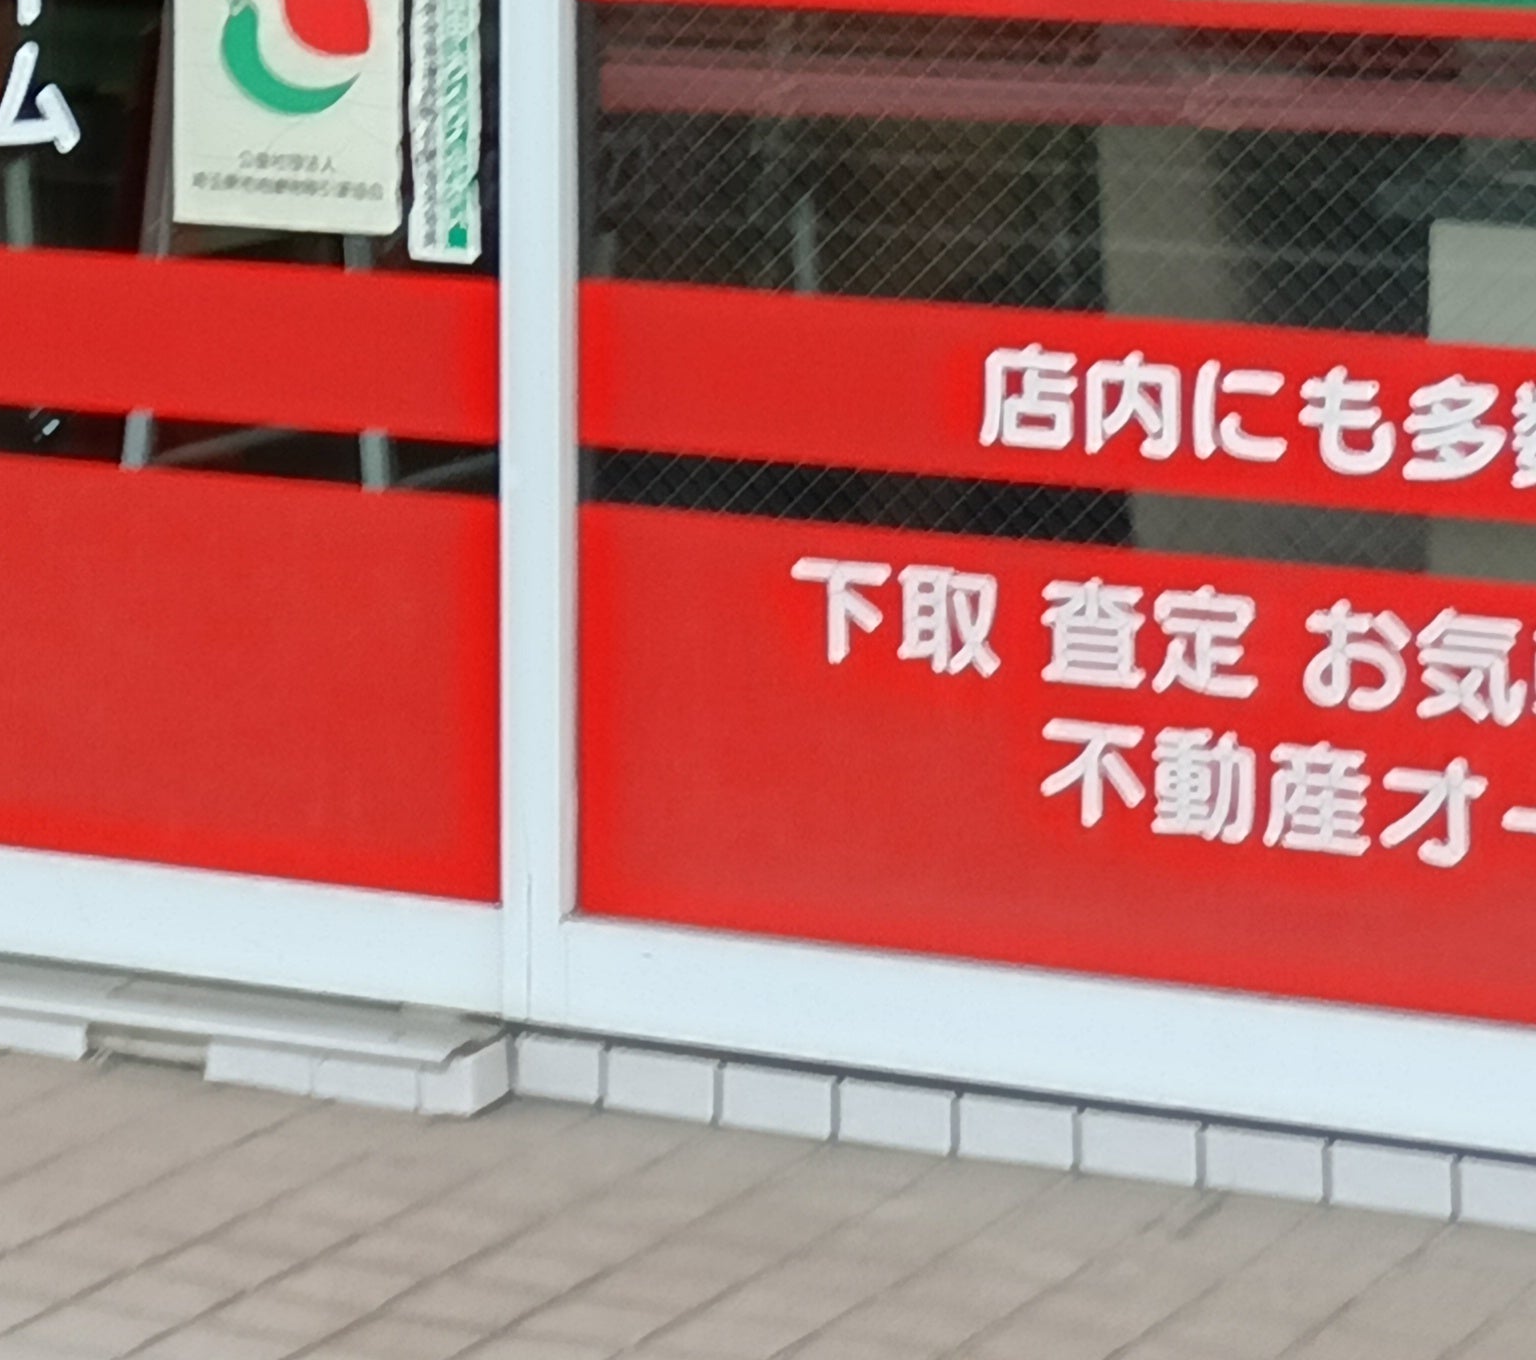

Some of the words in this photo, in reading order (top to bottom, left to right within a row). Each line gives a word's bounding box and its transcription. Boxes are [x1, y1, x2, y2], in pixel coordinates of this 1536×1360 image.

[978, 342, 1536, 490] 店内にも多
[790, 556, 1002, 679] 下取
[1040, 576, 1259, 700] 査定
[1302, 598, 1536, 727] お気
